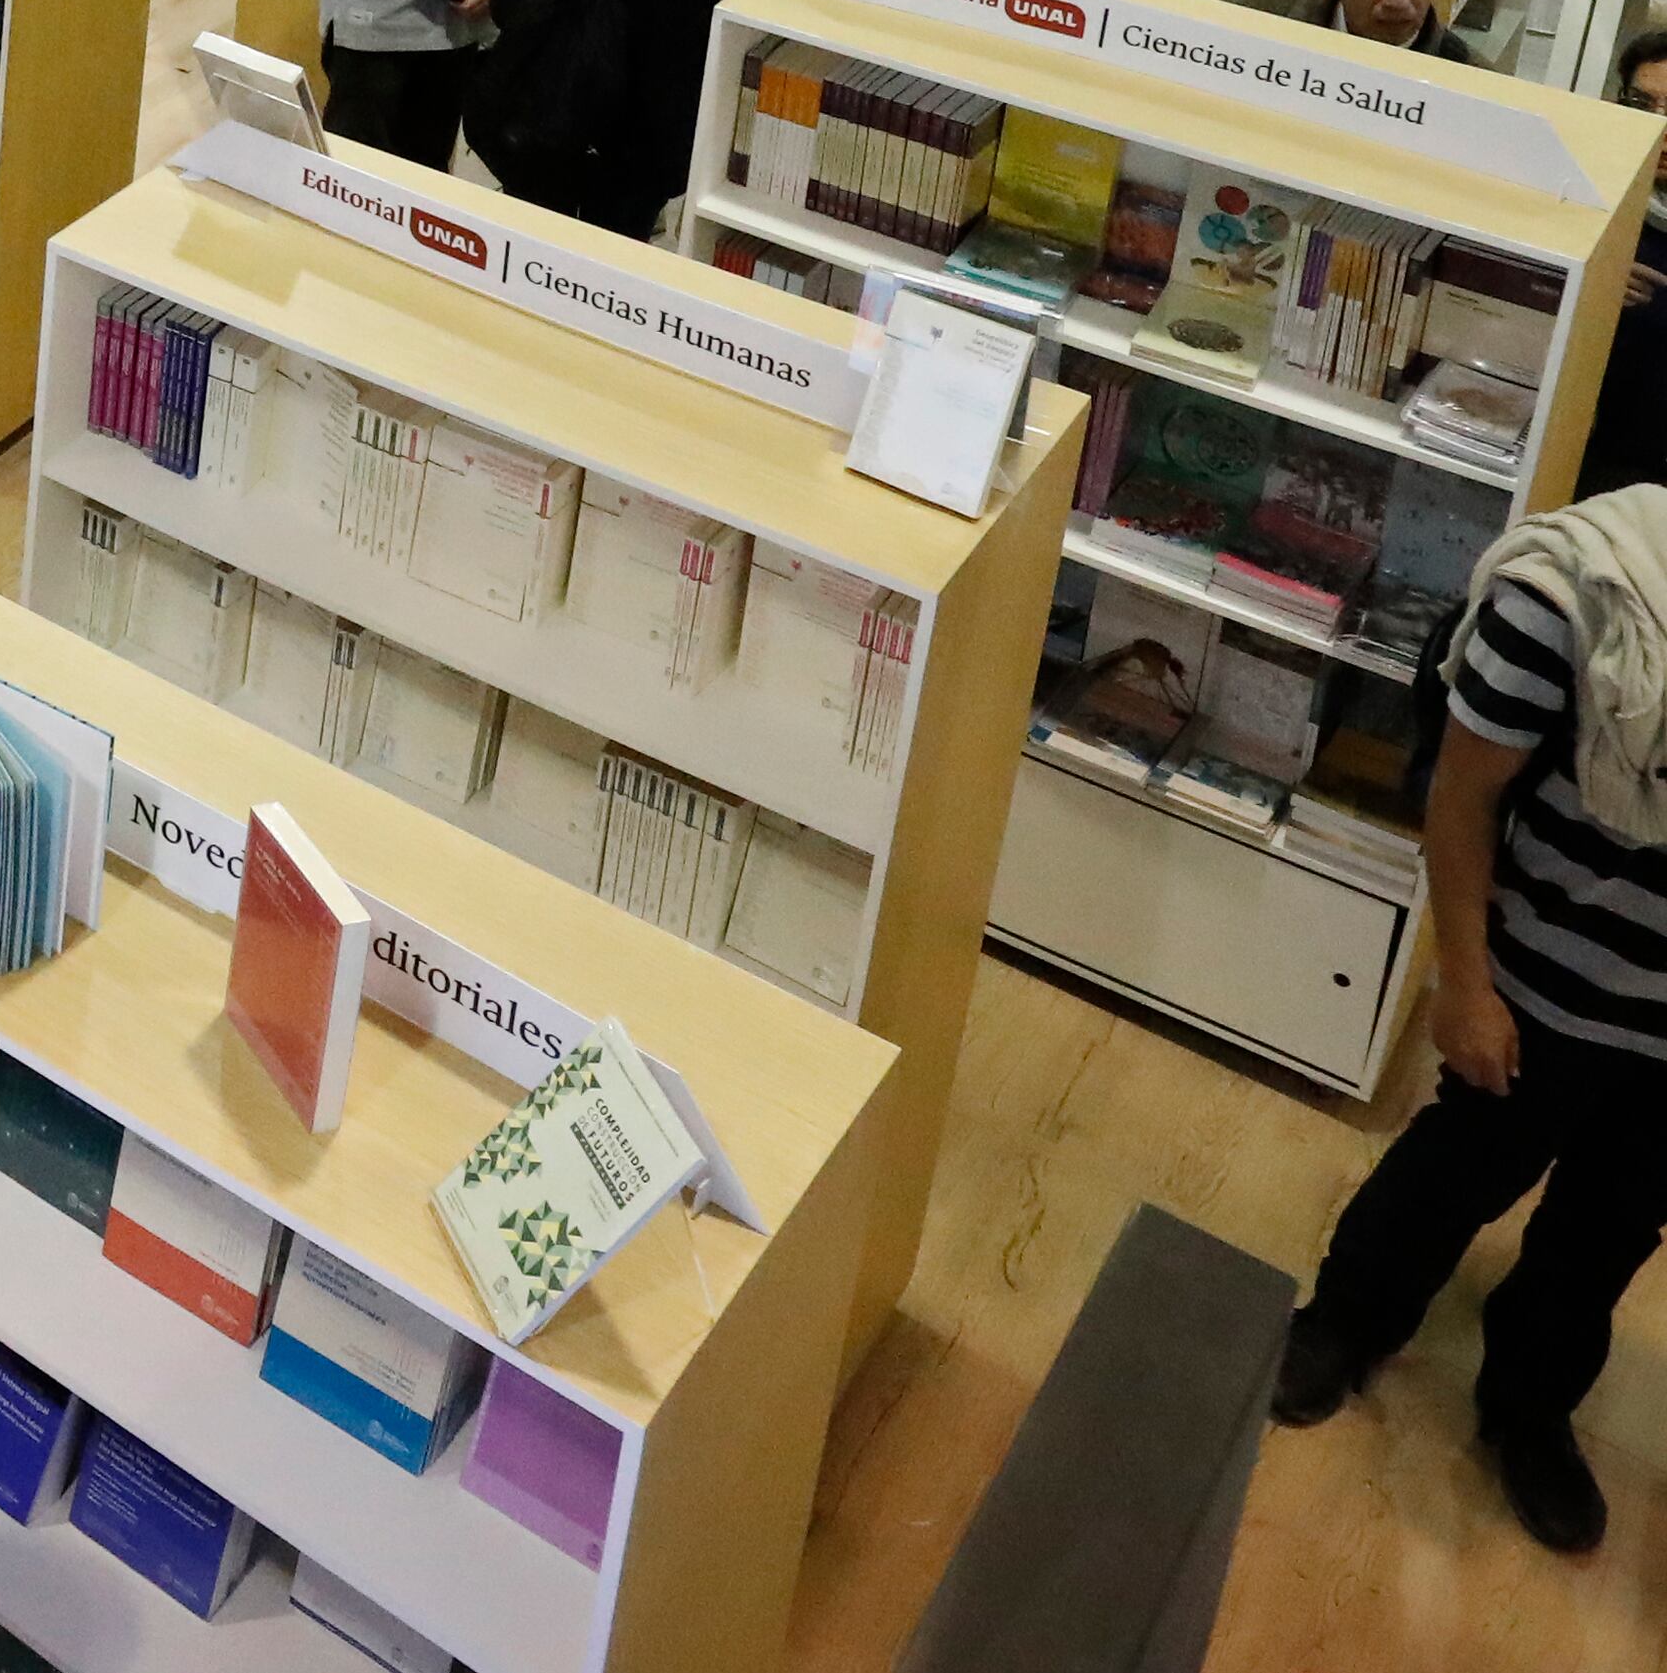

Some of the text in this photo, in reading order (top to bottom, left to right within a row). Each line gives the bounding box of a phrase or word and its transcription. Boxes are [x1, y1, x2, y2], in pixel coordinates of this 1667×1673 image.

[1123, 24, 1246, 76] Ciencias
[1254, 57, 1291, 86] de
[1302, 68, 1327, 99] la
[1336, 80, 1426, 126] Salud
[301, 166, 812, 390] Editorial UNAL Ciencias Humanas
[587, 1127, 635, 1203] FUTUROS
[595, 1097, 651, 1184] COMPLEJIDAD
